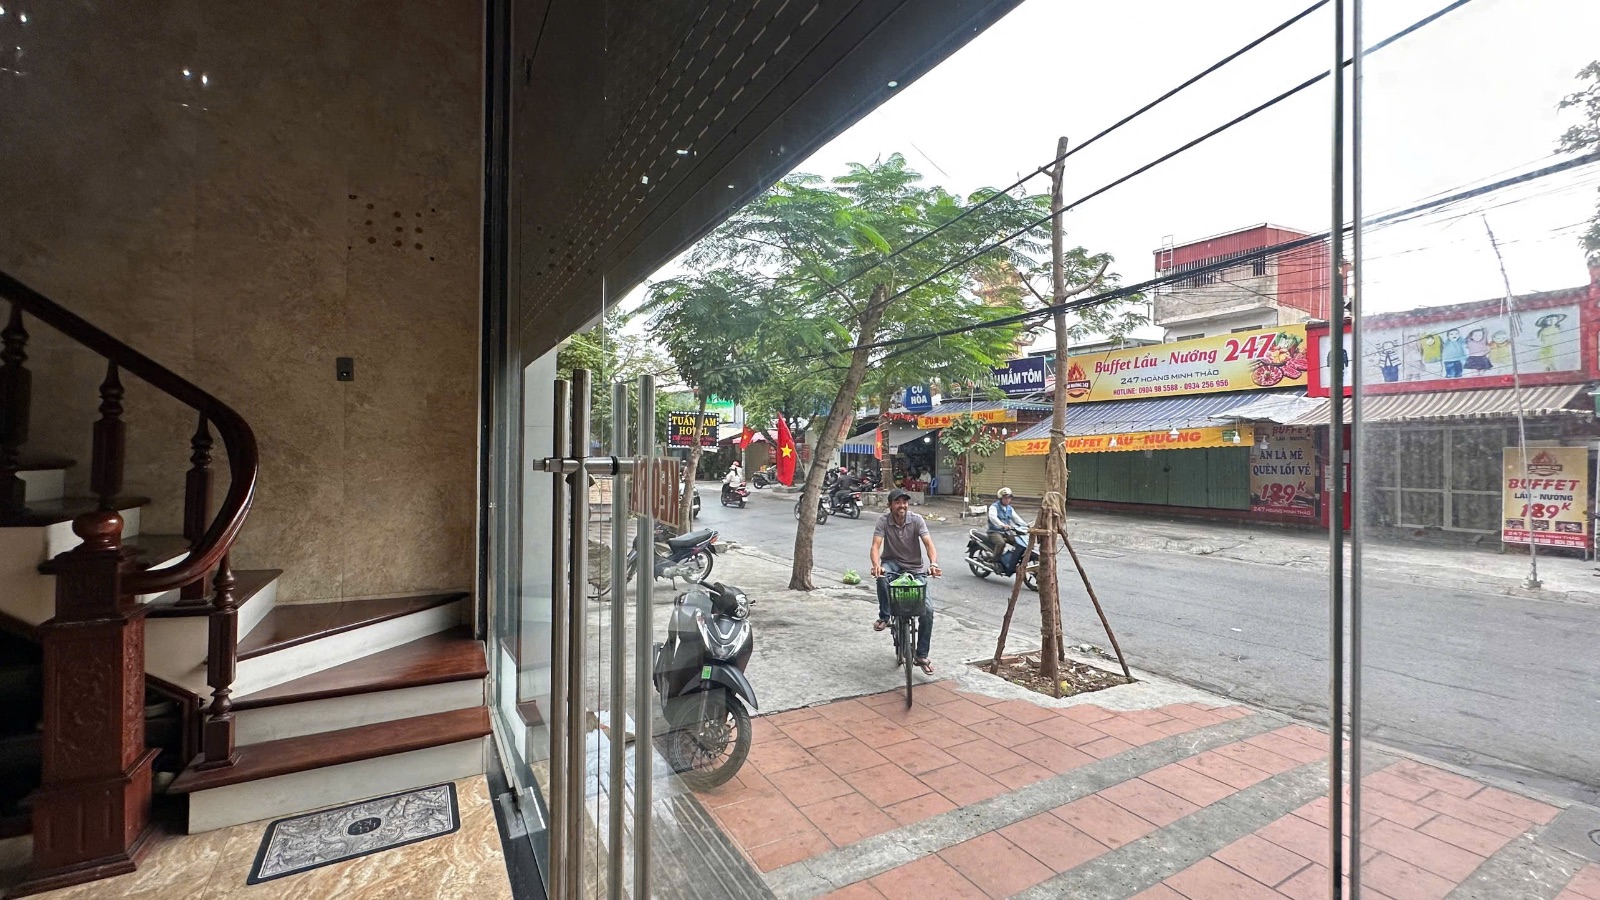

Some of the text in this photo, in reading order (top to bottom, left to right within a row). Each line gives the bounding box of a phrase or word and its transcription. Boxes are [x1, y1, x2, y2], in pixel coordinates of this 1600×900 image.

[1095, 357, 1131, 375] Buffet
[1134, 352, 1157, 369] Lẩu
[1169, 349, 1217, 368] Nướng
[1223, 333, 1277, 362] 247
[1001, 368, 1021, 386] MẮM
[1022, 368, 1042, 384] TÔM
[1120, 368, 1220, 385] 247 HOÀNG MINH THẢO
[1113, 387, 1138, 396] HOTLINE:
[1184, 382, 1200, 390] 0934
[1202, 381, 1214, 389] 256
[910, 394, 928, 405] HÒA
[1027, 441, 1048, 450] 247
[1275, 448, 1287, 460] LÀ
[1289, 448, 1303, 460] MÊ
[1253, 463, 1278, 476] QUÊN
[1279, 462, 1295, 475] LỐI
